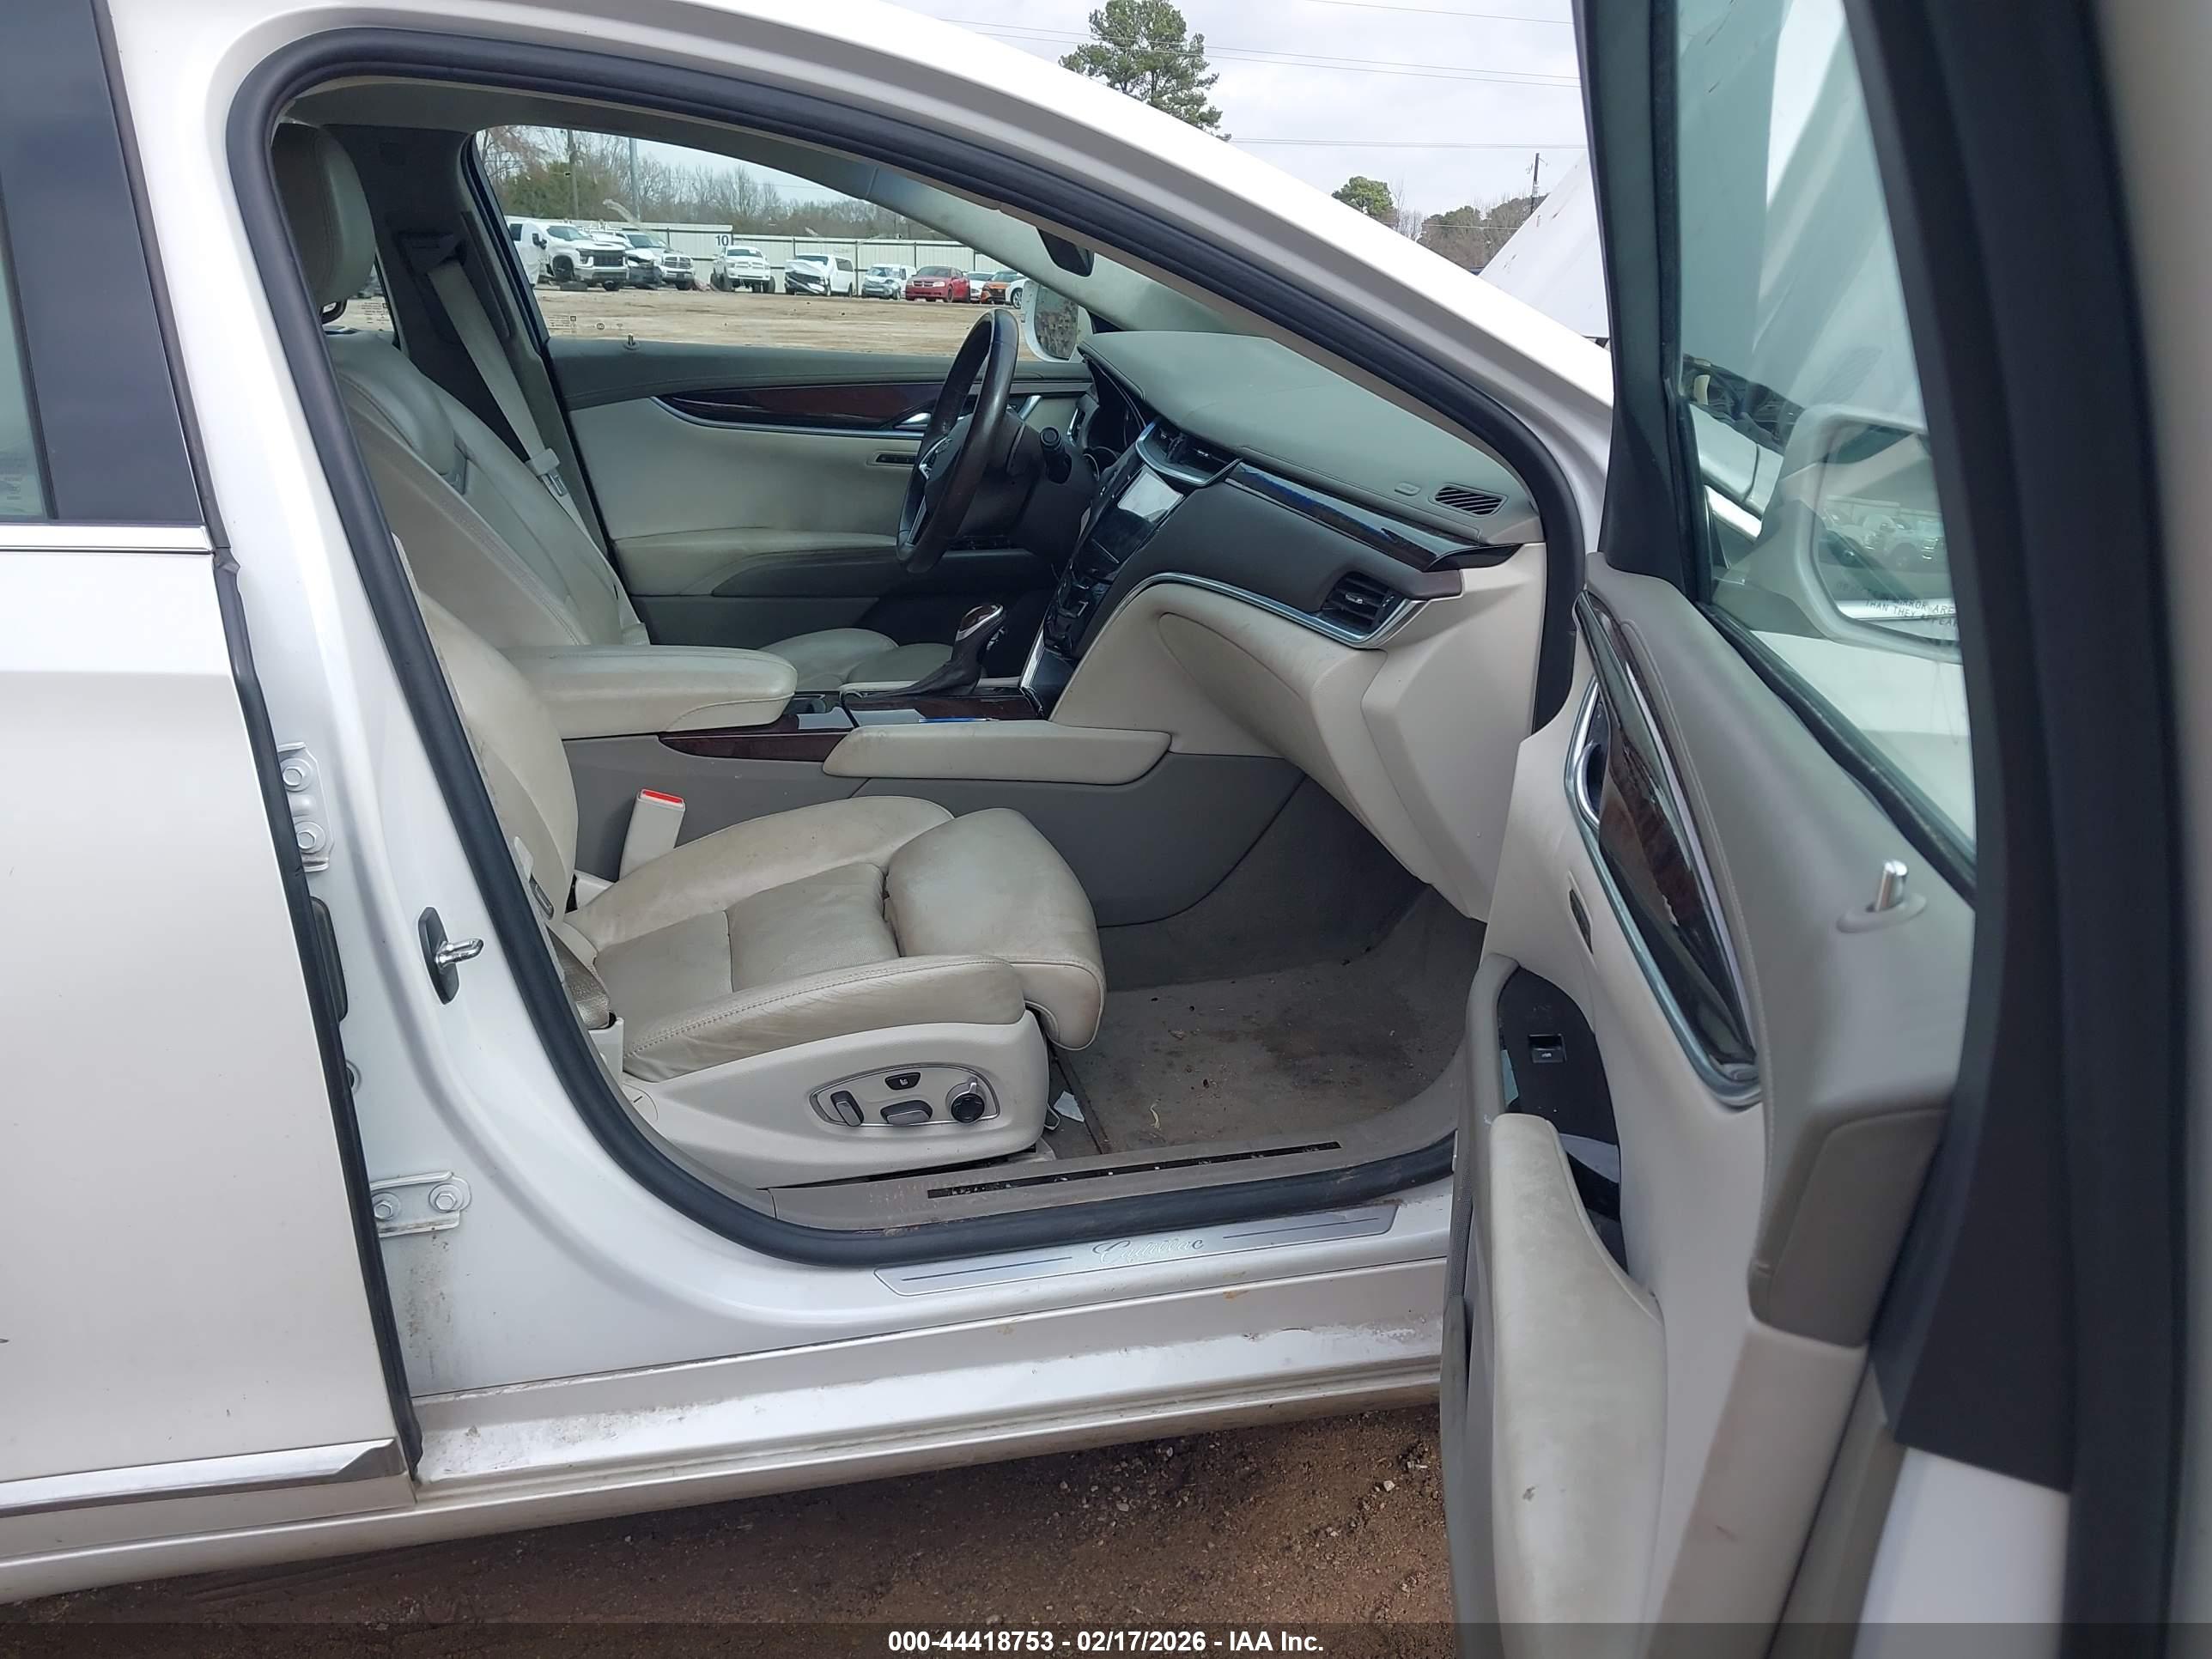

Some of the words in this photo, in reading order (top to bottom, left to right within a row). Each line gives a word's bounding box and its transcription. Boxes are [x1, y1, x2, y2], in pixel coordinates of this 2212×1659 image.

[714, 234, 729, 246] 10
[1865, 600, 1889, 612] THAN
[1893, 605, 1916, 617] THEY
